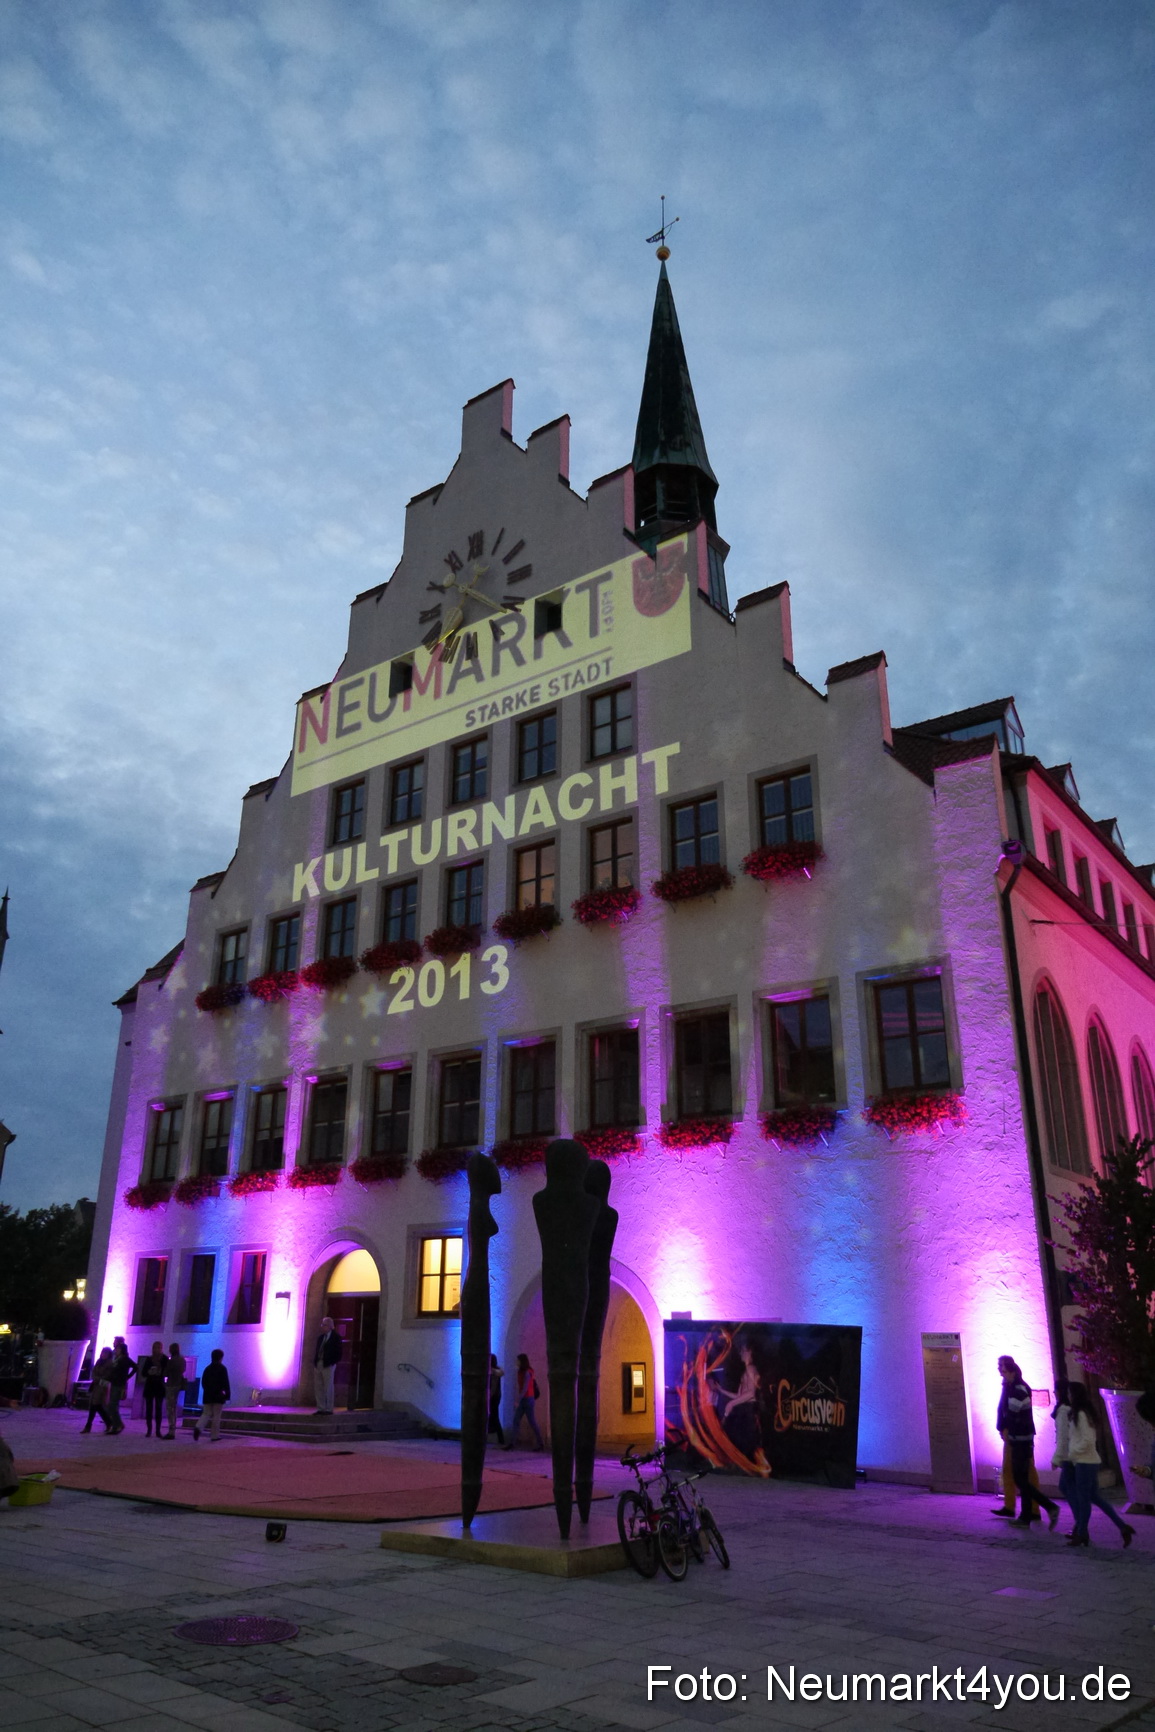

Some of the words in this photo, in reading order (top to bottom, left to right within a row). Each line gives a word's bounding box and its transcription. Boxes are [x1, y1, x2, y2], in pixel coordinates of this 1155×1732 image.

[465, 685, 541, 728] STARKE
[548, 657, 614, 698] STADT
[292, 742, 681, 903] KULTURNACHT
[387, 944, 510, 1015] 2013
